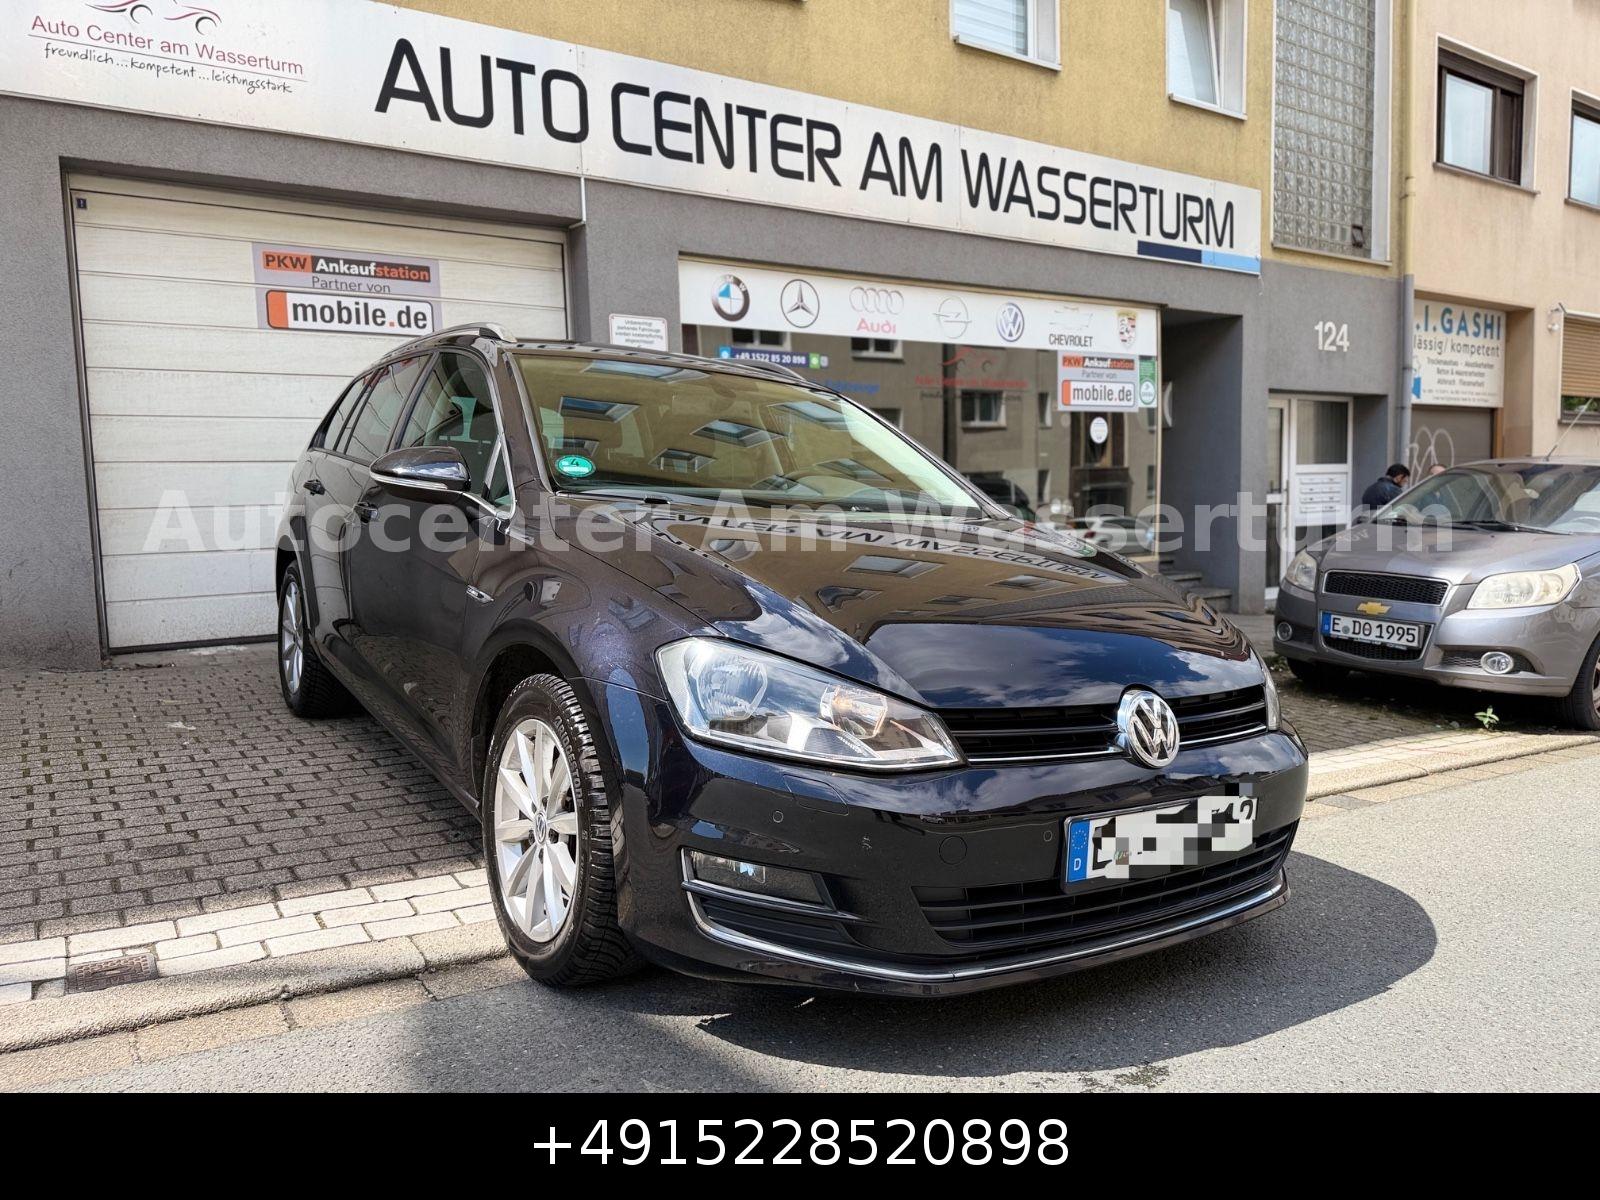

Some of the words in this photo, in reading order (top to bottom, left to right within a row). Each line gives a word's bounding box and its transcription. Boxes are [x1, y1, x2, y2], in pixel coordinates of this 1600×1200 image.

[31, 15, 80, 38] Auto
[87, 24, 153, 50] Center
[160, 41, 189, 56] am
[195, 42, 304, 75] Wasserturm
[375, 37, 589, 144] AUTO
[611, 81, 842, 187] CENTER
[859, 131, 942, 201] AM
[961, 148, 1235, 249] WASSERTURM
[265, 253, 307, 270] PKW
[315, 257, 430, 281] Ankaufstation
[312, 275, 363, 292] Partner
[367, 281, 391, 294] von
[292, 300, 428, 330] mobile.de
[856, 317, 896, 334] Audi
[1048, 332, 1094, 348] CHEVROLET
[1314, 320, 1350, 352] 124
[1450, 338, 1500, 358] kompetent
[782, 355, 792, 364] 20
[1082, 368, 1103, 379] Partner
[1105, 370, 1118, 380] von
[1072, 381, 1132, 402] mobile.de
[1332, 617, 1341, 633] E
[1375, 624, 1417, 643] 1995
[1073, 857, 1082, 871] D
